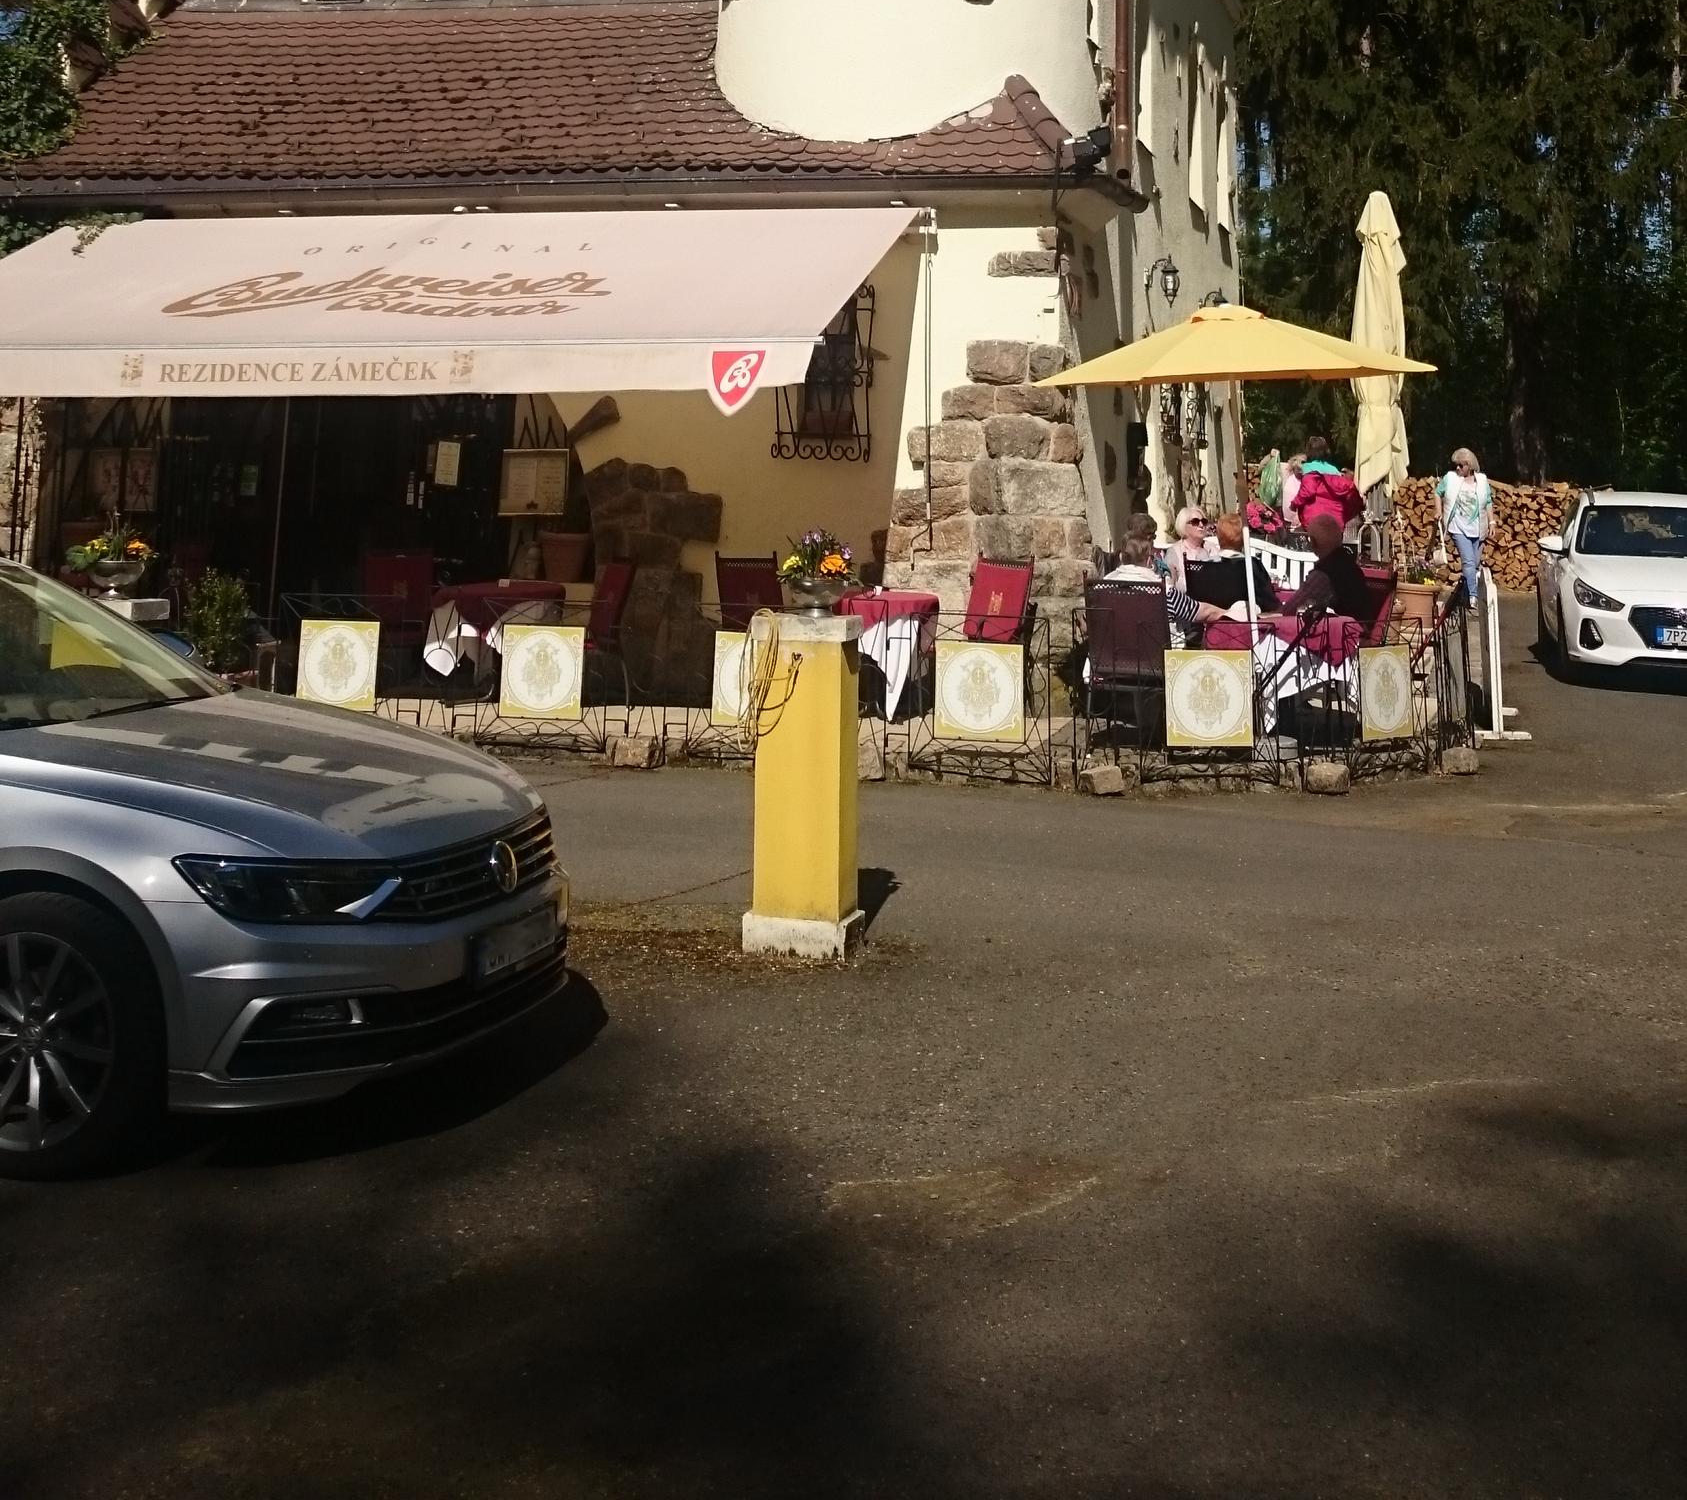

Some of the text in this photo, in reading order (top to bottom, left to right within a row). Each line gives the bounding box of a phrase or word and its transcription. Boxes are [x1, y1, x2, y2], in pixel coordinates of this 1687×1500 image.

[303, 236, 594, 256] ORIGINAL
[161, 267, 612, 318] Budweiser
[325, 290, 581, 318] Budvar
[158, 355, 440, 383] REZIDENCE ZÁMEČEK
